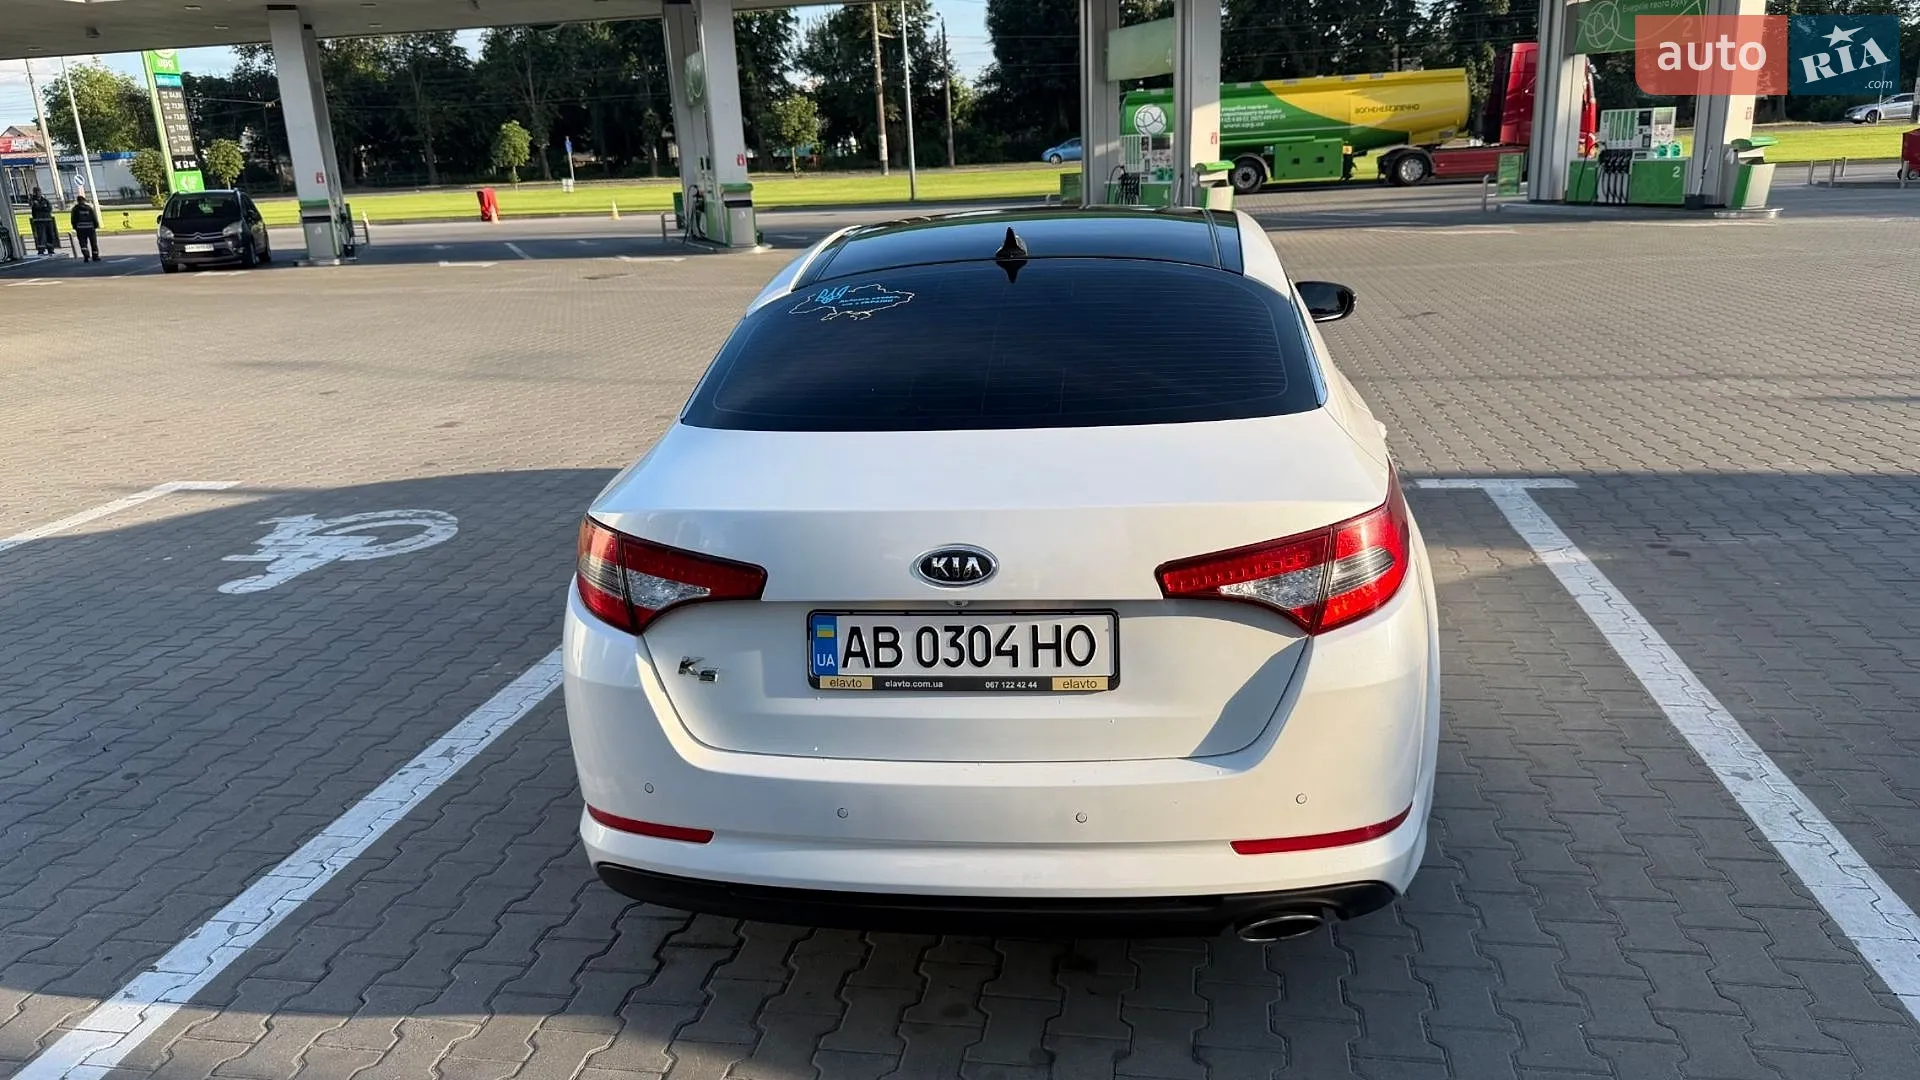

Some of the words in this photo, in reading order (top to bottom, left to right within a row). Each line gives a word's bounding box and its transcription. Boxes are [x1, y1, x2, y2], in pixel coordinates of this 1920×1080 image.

[1672, 166, 1681, 178] 2
[932, 556, 983, 577] KIA
[842, 625, 903, 668] AB
[916, 624, 1019, 669] 0304
[1031, 624, 1096, 668] HO
[817, 654, 835, 667] UA
[829, 678, 862, 688] elavto
[885, 680, 943, 689] elavto.com.ua
[985, 681, 999, 689] 067
[1001, 681, 1015, 689] 122
[1017, 681, 1026, 689] 42
[1062, 678, 1098, 689] elavto
